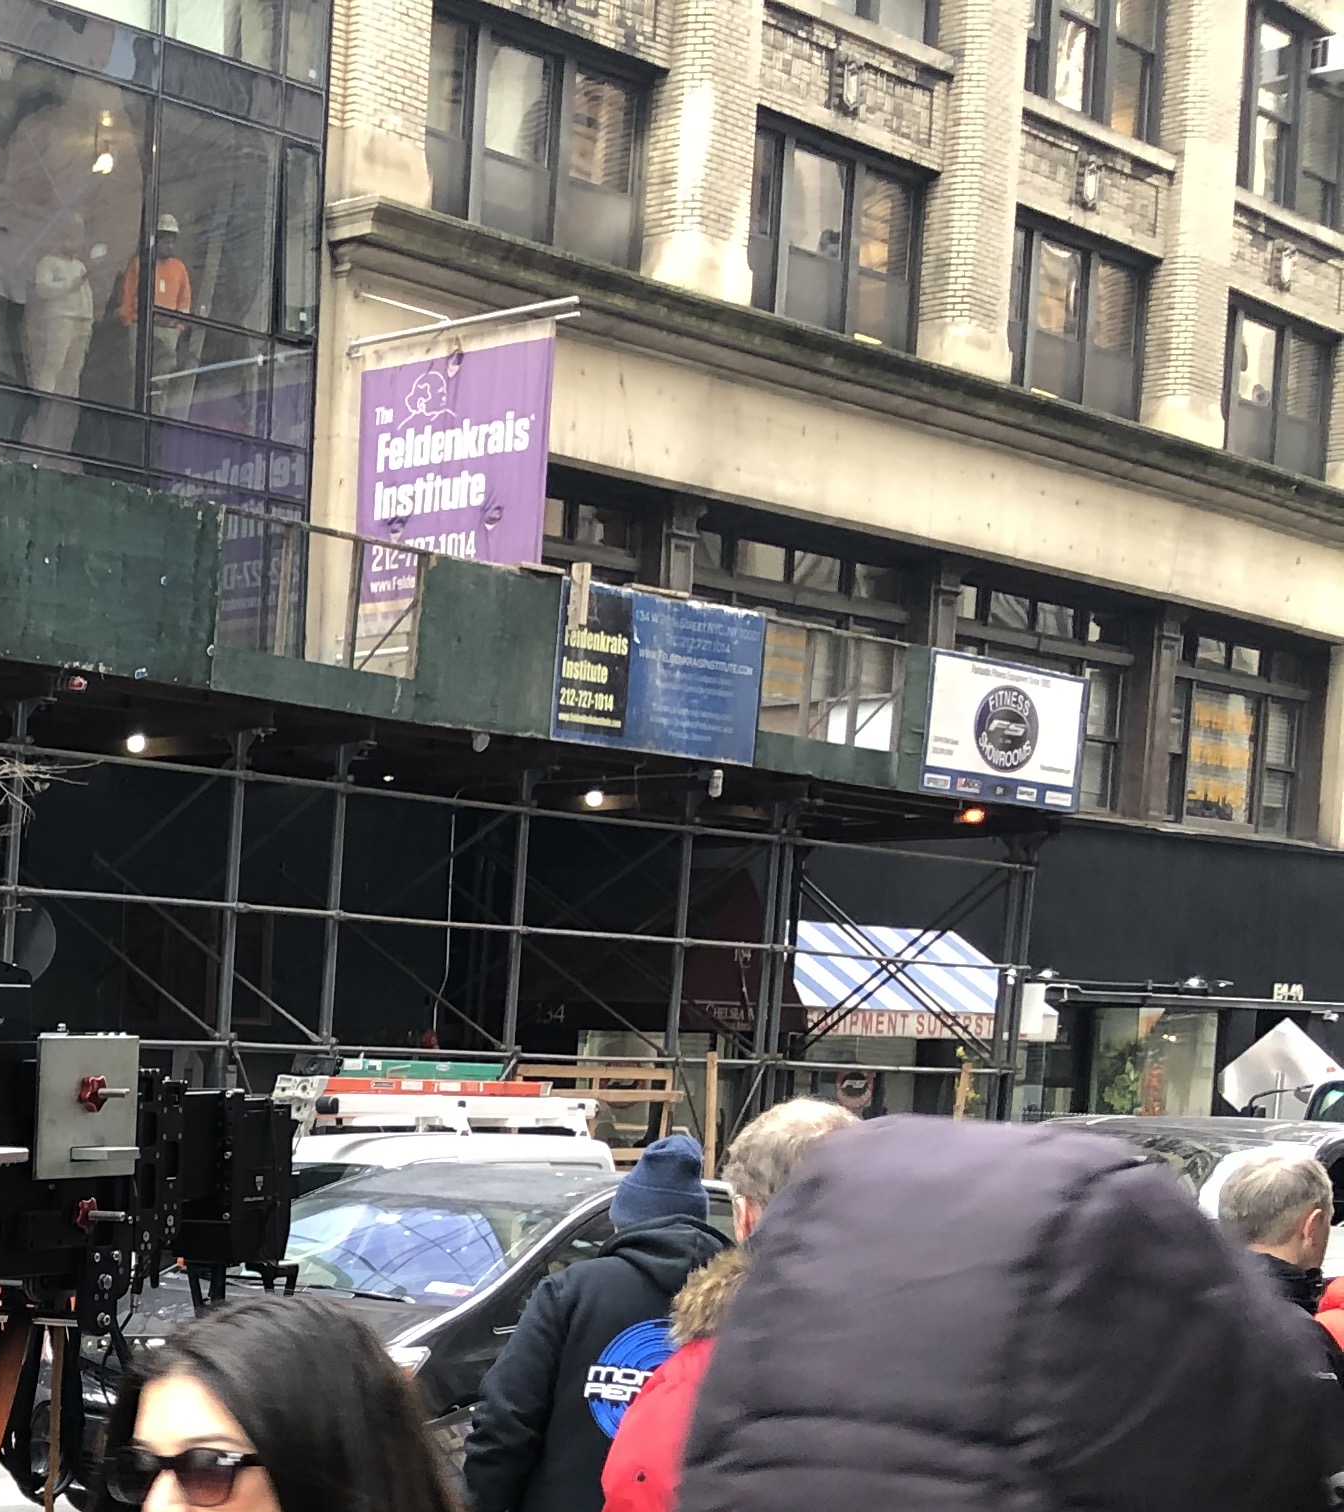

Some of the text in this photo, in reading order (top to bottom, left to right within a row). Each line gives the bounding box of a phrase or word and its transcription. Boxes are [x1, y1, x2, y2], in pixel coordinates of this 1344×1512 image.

[375, 406, 394, 426] The
[376, 411, 531, 473] Feldenkrais
[373, 470, 486, 521] Institute
[562, 656, 609, 685] Institute
[559, 688, 615, 712] 212-727-1014
[988, 690, 1031, 716] FITNESS
[988, 719, 1027, 737] FS
[978, 731, 1032, 767] SHOWROOMS
